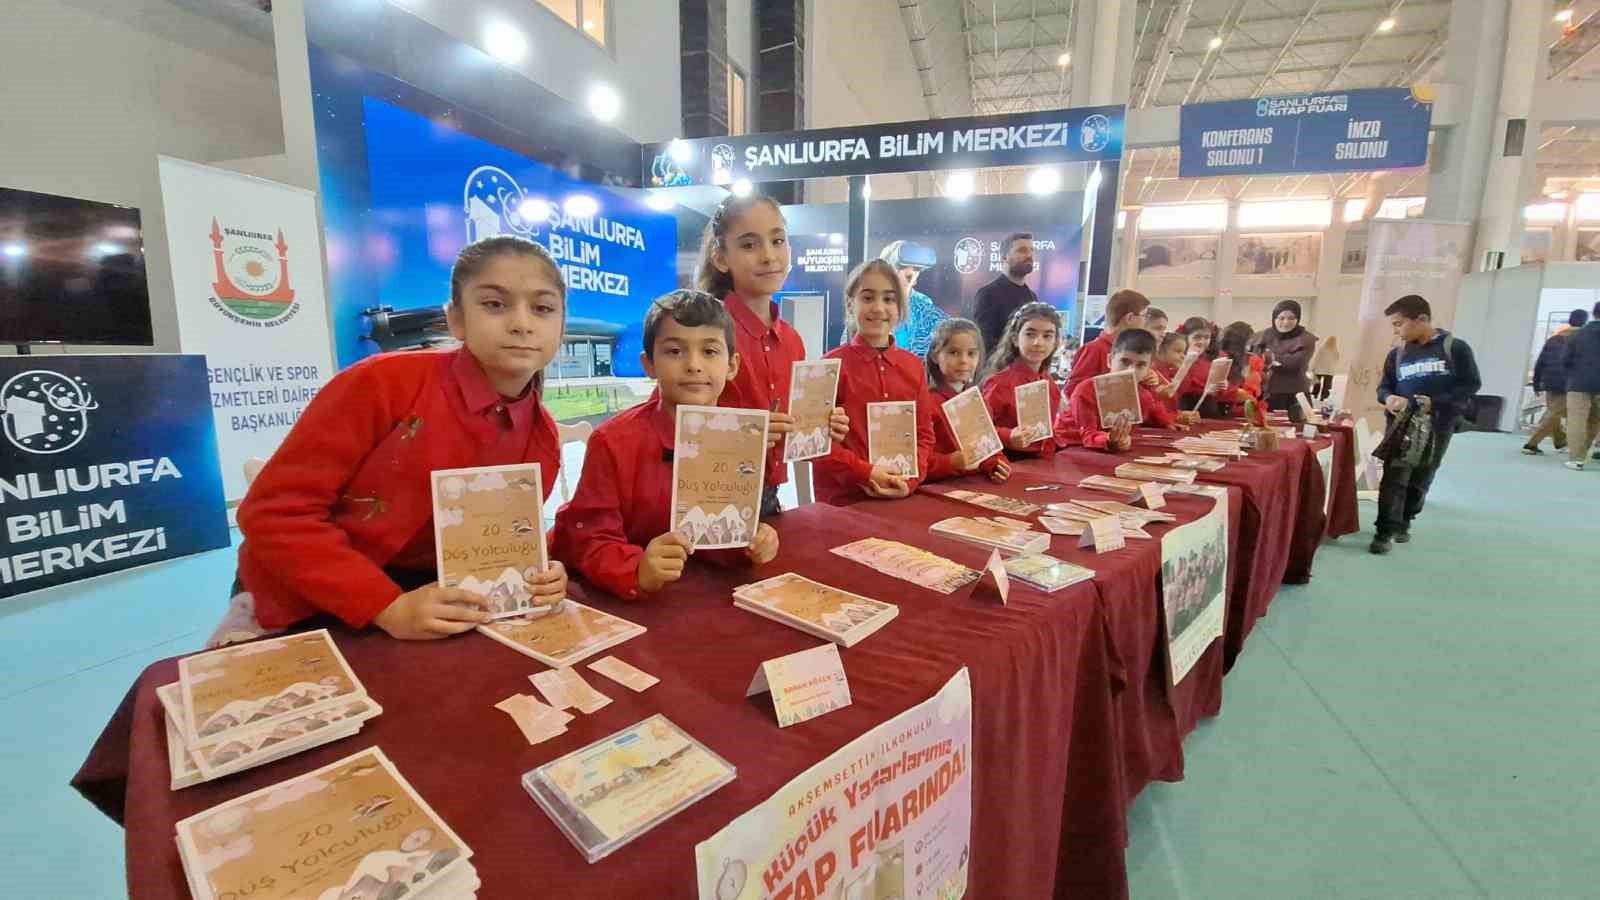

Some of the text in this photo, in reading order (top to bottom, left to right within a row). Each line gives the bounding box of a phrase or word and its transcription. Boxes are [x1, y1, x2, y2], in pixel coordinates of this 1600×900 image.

[1202, 127, 1273, 148] KONFERANS
[1347, 118, 1382, 139] İMZA
[744, 138, 871, 170] ŞANLIURFA
[1207, 147, 1264, 167] SALONU 1
[1335, 141, 1388, 161] SALONU
[267, 366, 284, 381] VE
[287, 365, 318, 380] SPOR
[712, 461, 729, 473] 20
[481, 523, 501, 537] 20
[297, 822, 333, 847] 20
